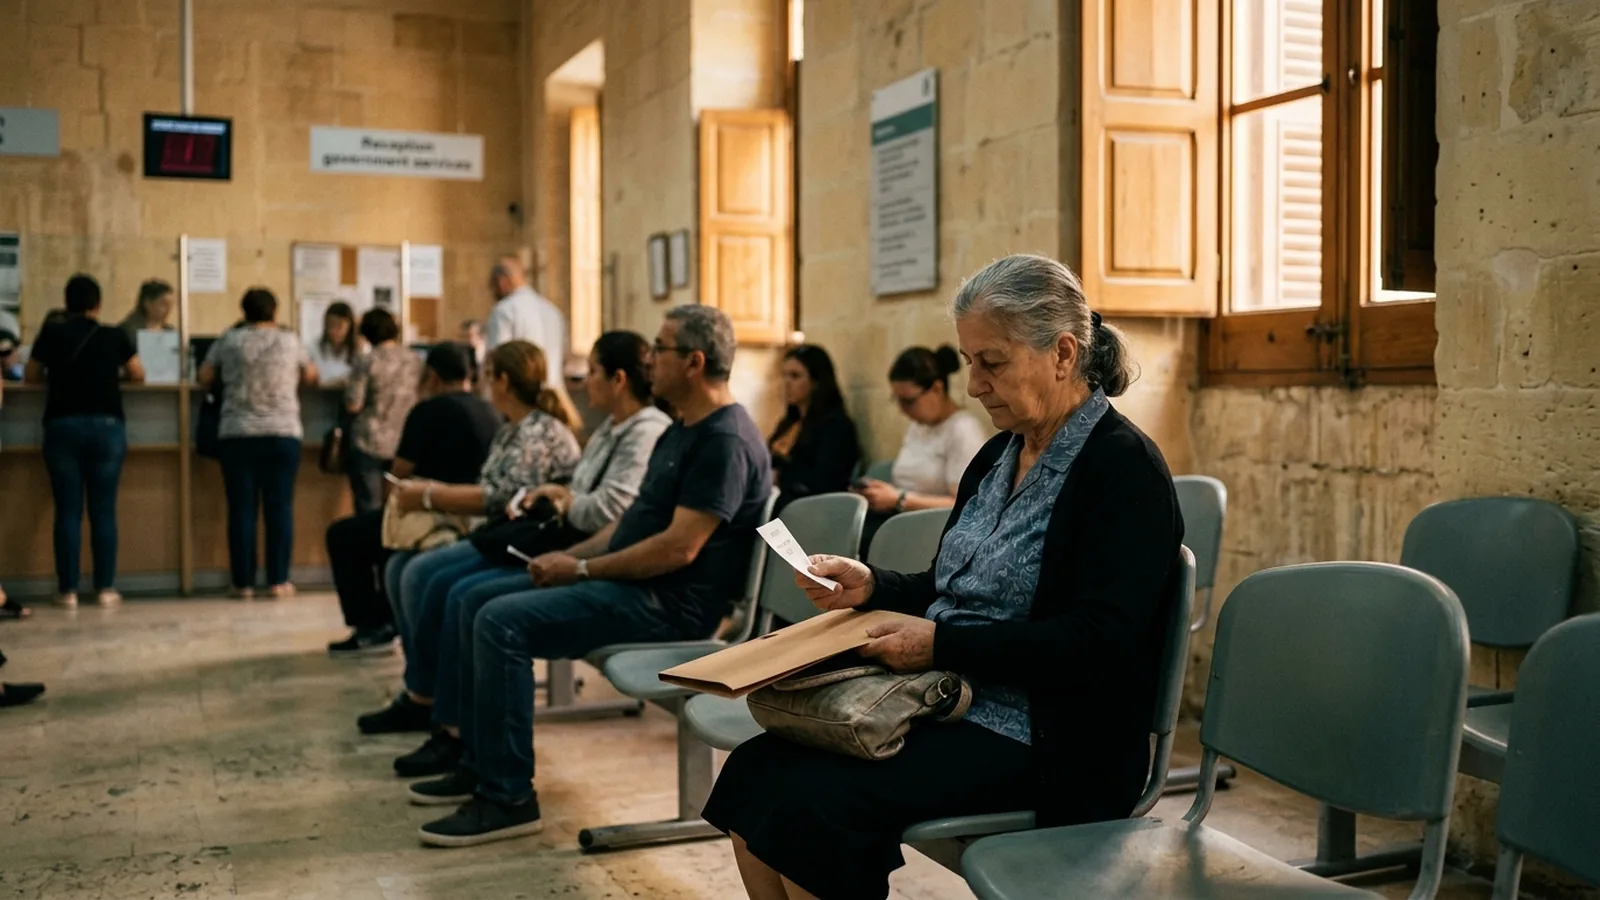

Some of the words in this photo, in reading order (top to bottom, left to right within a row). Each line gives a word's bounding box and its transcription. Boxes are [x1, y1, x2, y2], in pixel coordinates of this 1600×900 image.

[361, 135, 435, 152] Reception
[322, 153, 408, 167] government
[413, 156, 472, 170] services
